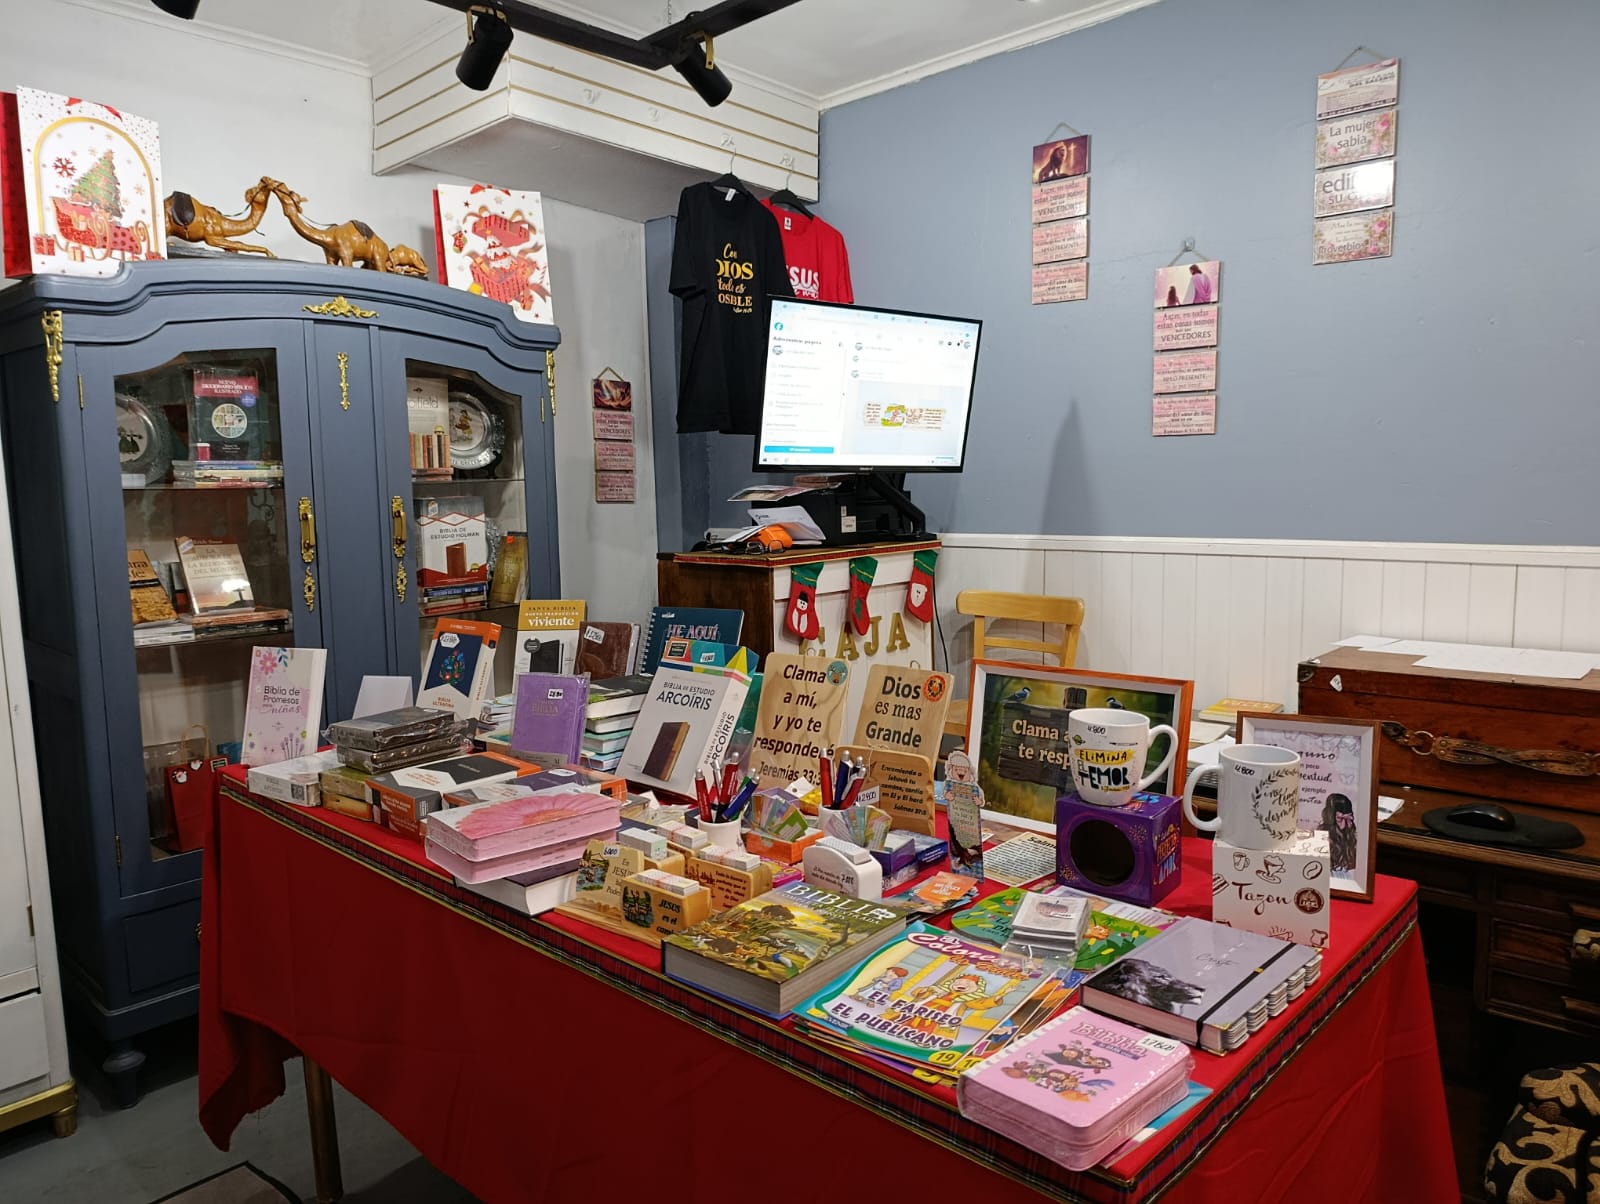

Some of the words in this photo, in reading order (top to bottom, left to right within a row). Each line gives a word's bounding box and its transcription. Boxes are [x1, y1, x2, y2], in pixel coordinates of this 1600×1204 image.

[1329, 127, 1342, 137] La
[1345, 120, 1376, 134] mujer
[1336, 134, 1367, 149] sabia
[1327, 193, 1343, 205] su
[1160, 330, 1212, 341] VENCEDORES
[528, 616, 575, 627] viviente
[783, 664, 827, 684] Clama
[264, 685, 287, 696] Biblia
[288, 687, 301, 696] de
[663, 681, 682, 690] BIBLIA
[689, 686, 716, 696] ESTUDIO
[881, 675, 922, 700] Dios
[263, 694, 300, 705] Promesas
[656, 690, 713, 710] ARCOÍRIS
[783, 691, 793, 704] a
[795, 691, 817, 709] mí,
[874, 700, 889, 715] es
[891, 703, 922, 721] mas
[772, 714, 784, 730] y
[785, 716, 803, 731] yo
[806, 717, 822, 733] te
[1012, 719, 1059, 741] Clama
[865, 720, 922, 748] Grande
[753, 736, 835, 760] respondeé
[1018, 743, 1034, 760] te
[758, 761, 800, 782] Jeremías
[1078, 765, 1130, 790] TEMOR
[1231, 881, 1292, 916] Tazon
[662, 915, 669, 923] es
[868, 990, 889, 1005] EL
[891, 998, 962, 1028] FARISEO
[832, 1002, 853, 1018] EL
[854, 1012, 955, 1049] PUBLICANO
[1070, 1021, 1148, 1059] Biblia
[935, 1052, 956, 1063] 19
